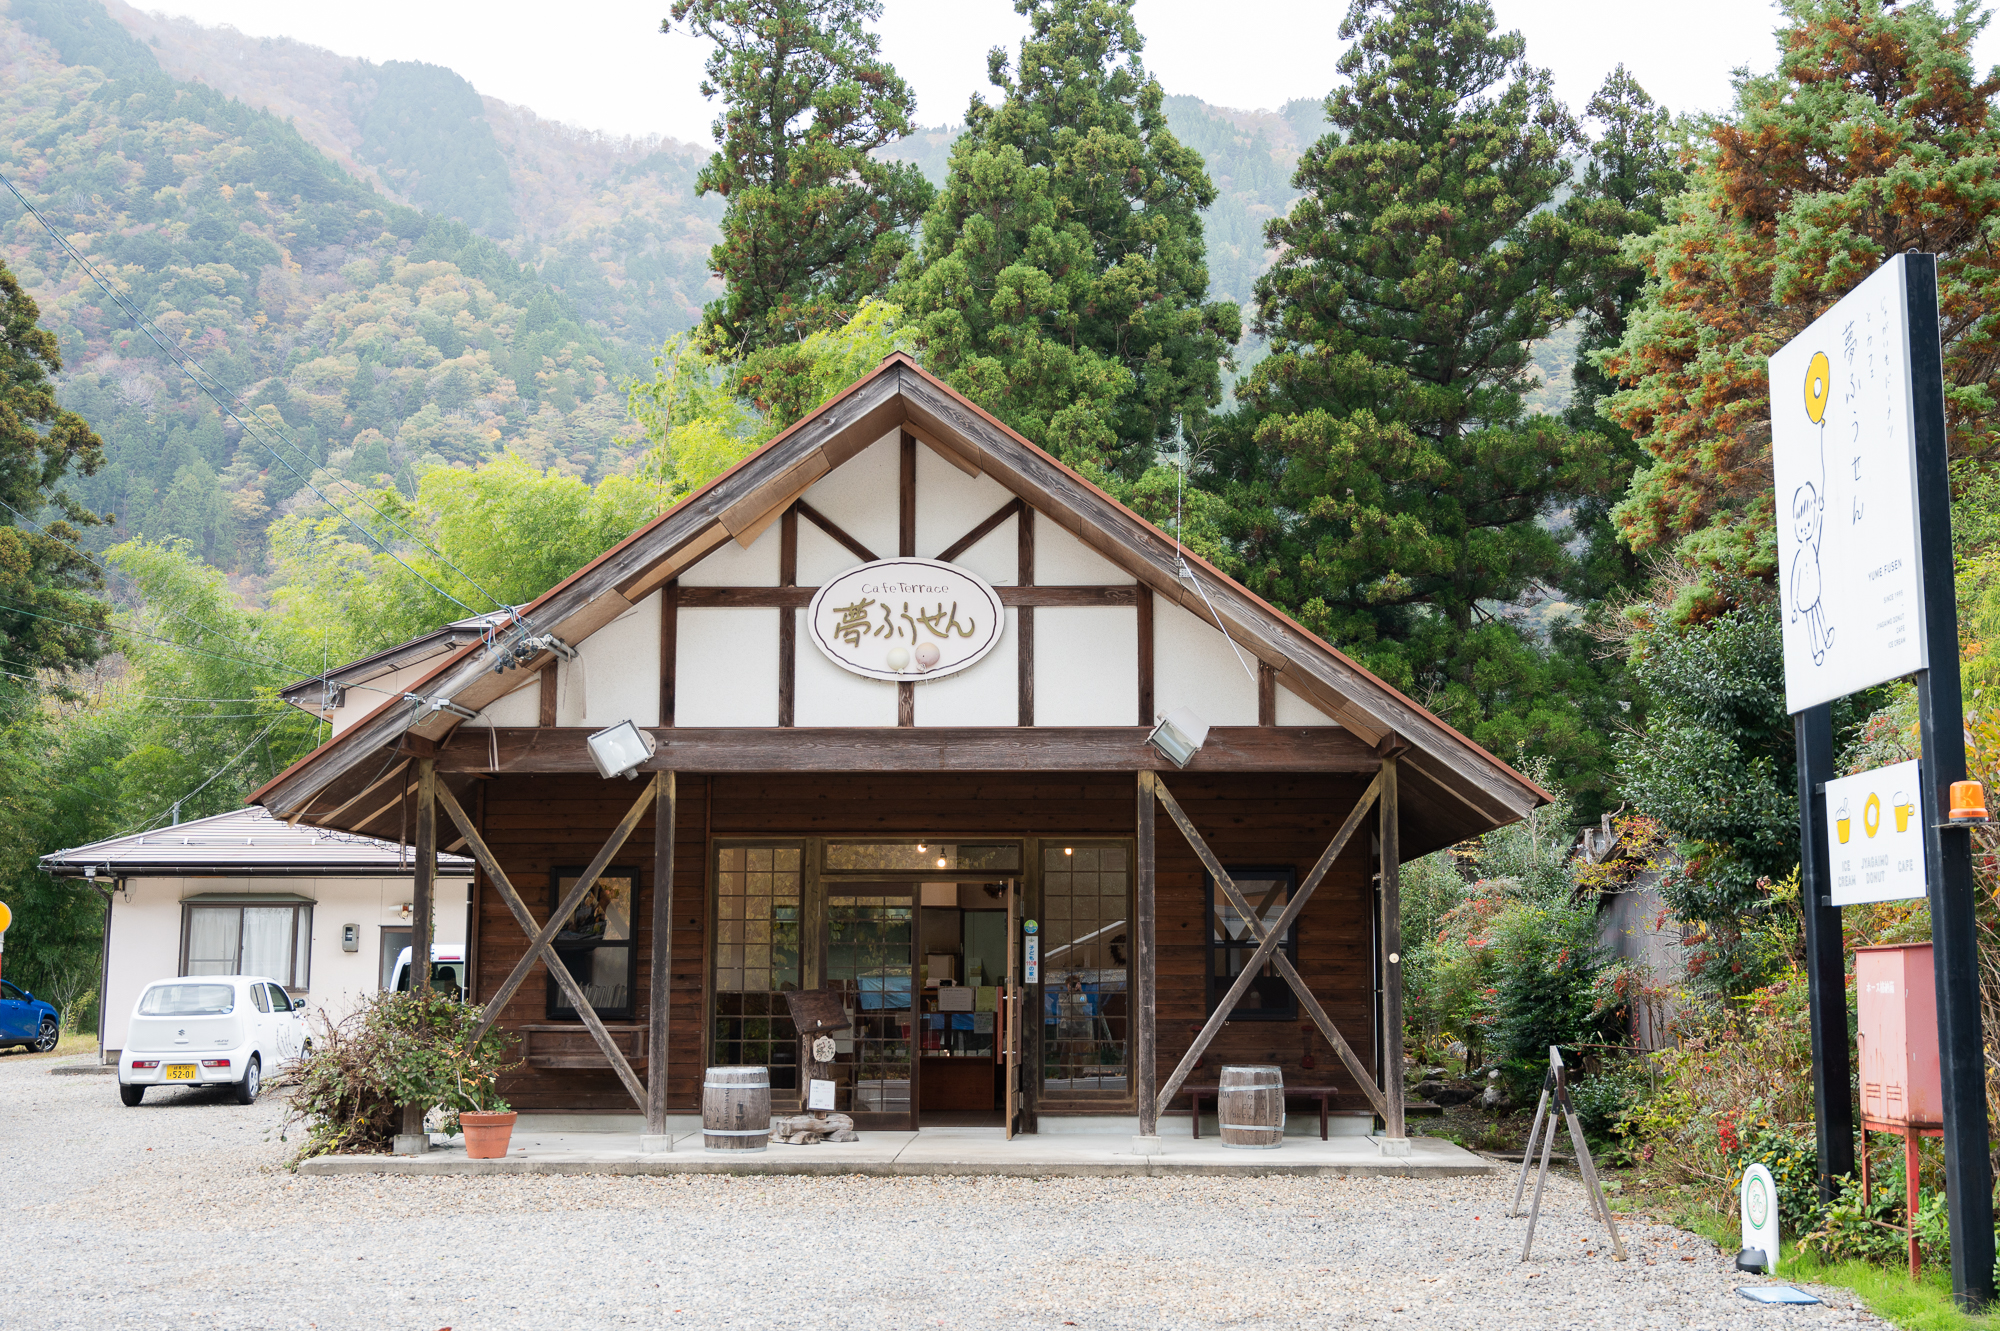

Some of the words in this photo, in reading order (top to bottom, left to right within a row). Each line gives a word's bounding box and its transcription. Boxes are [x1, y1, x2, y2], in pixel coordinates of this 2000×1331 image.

[1866, 312, 1874, 379] とカフェ
[1842, 320, 1864, 525] 夢ふうせん
[1868, 566, 1882, 582] YUME
[1884, 558, 1902, 575] FUSEN
[833, 597, 975, 648] 夢ふうせん
[1841, 859, 1851, 872] ICE
[1861, 854, 1889, 870] JYAGAIMO
[1898, 858, 1914, 873] CAFE
[1838, 874, 1856, 888] CREAM
[1865, 870, 1885, 884] DONUT
